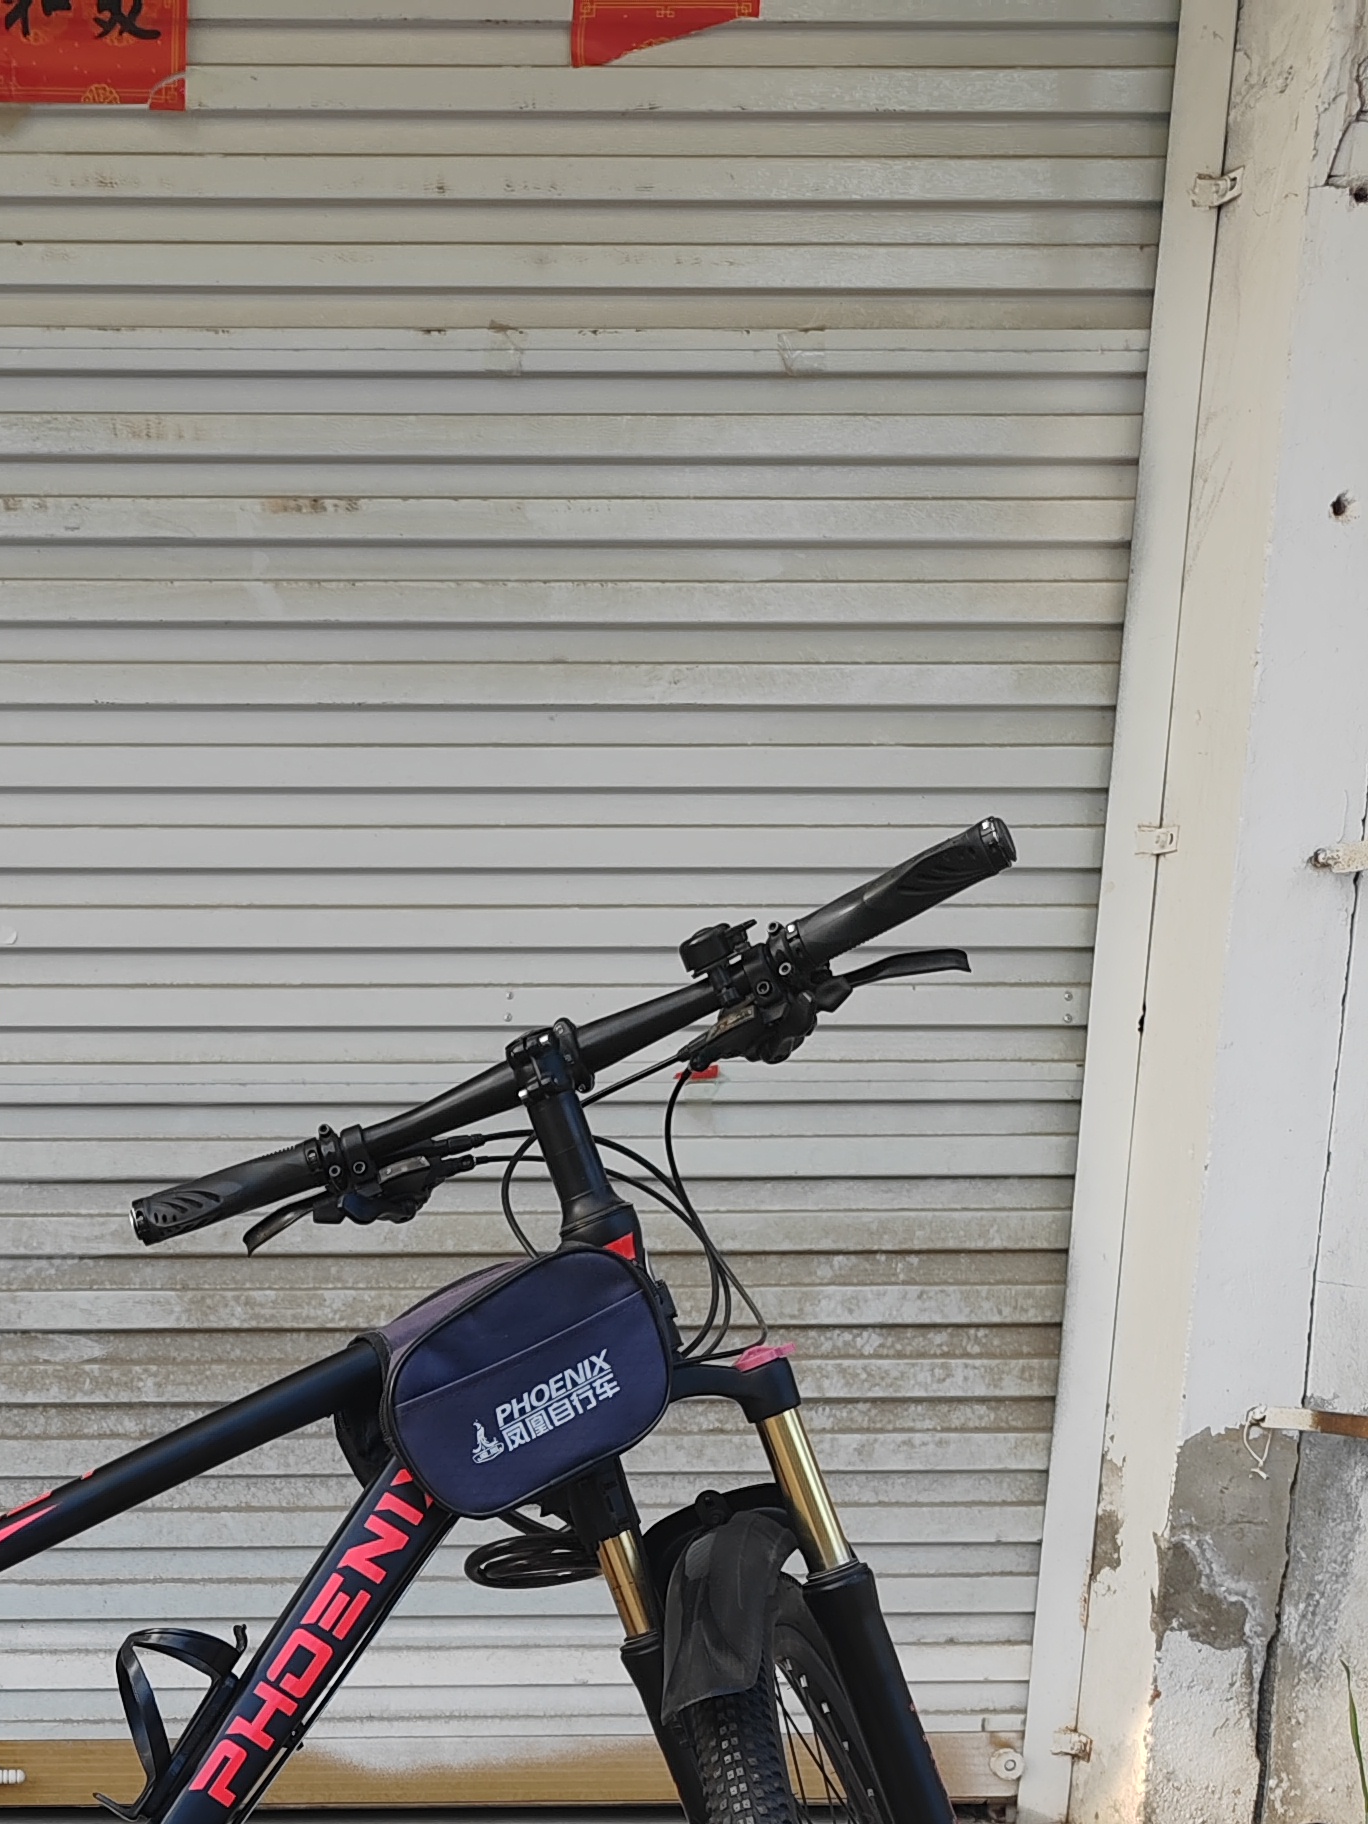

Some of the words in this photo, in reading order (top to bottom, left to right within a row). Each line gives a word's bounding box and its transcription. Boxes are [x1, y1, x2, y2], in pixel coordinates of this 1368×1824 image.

[495, 1348, 612, 1429] PHOENIX
[501, 1372, 621, 1452] 凤凰自行车
[189, 1468, 434, 1808] PHOENI
